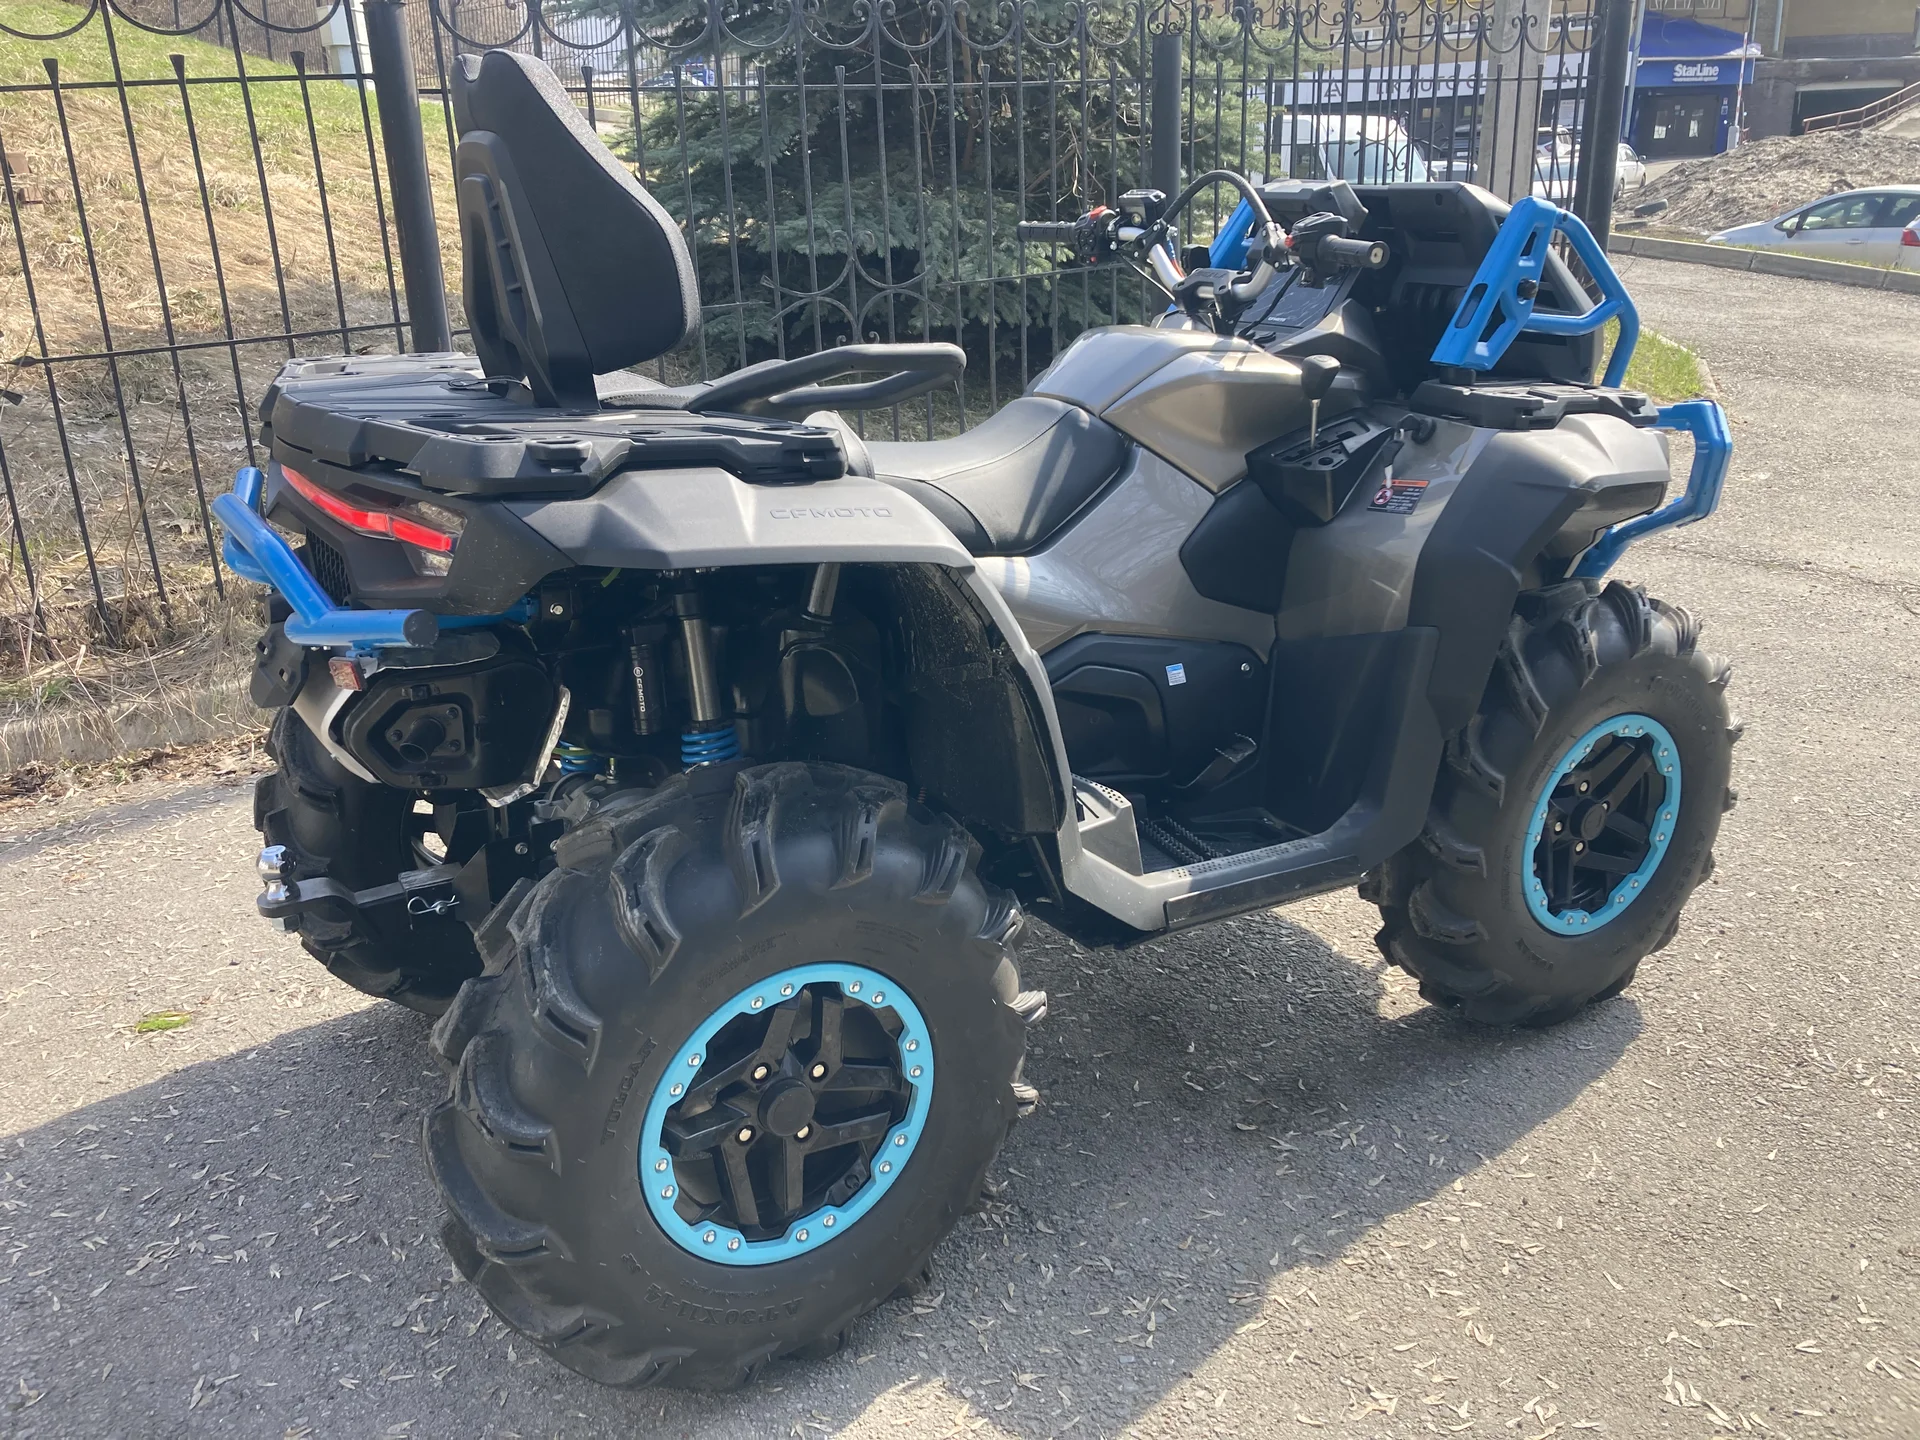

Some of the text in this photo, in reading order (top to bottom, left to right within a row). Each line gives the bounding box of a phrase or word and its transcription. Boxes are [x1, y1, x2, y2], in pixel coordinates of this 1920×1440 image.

[1673, 63, 1719, 77] StarLine
[769, 507, 893, 520] CFMOTO
[636, 677, 646, 713] CFMOTO
